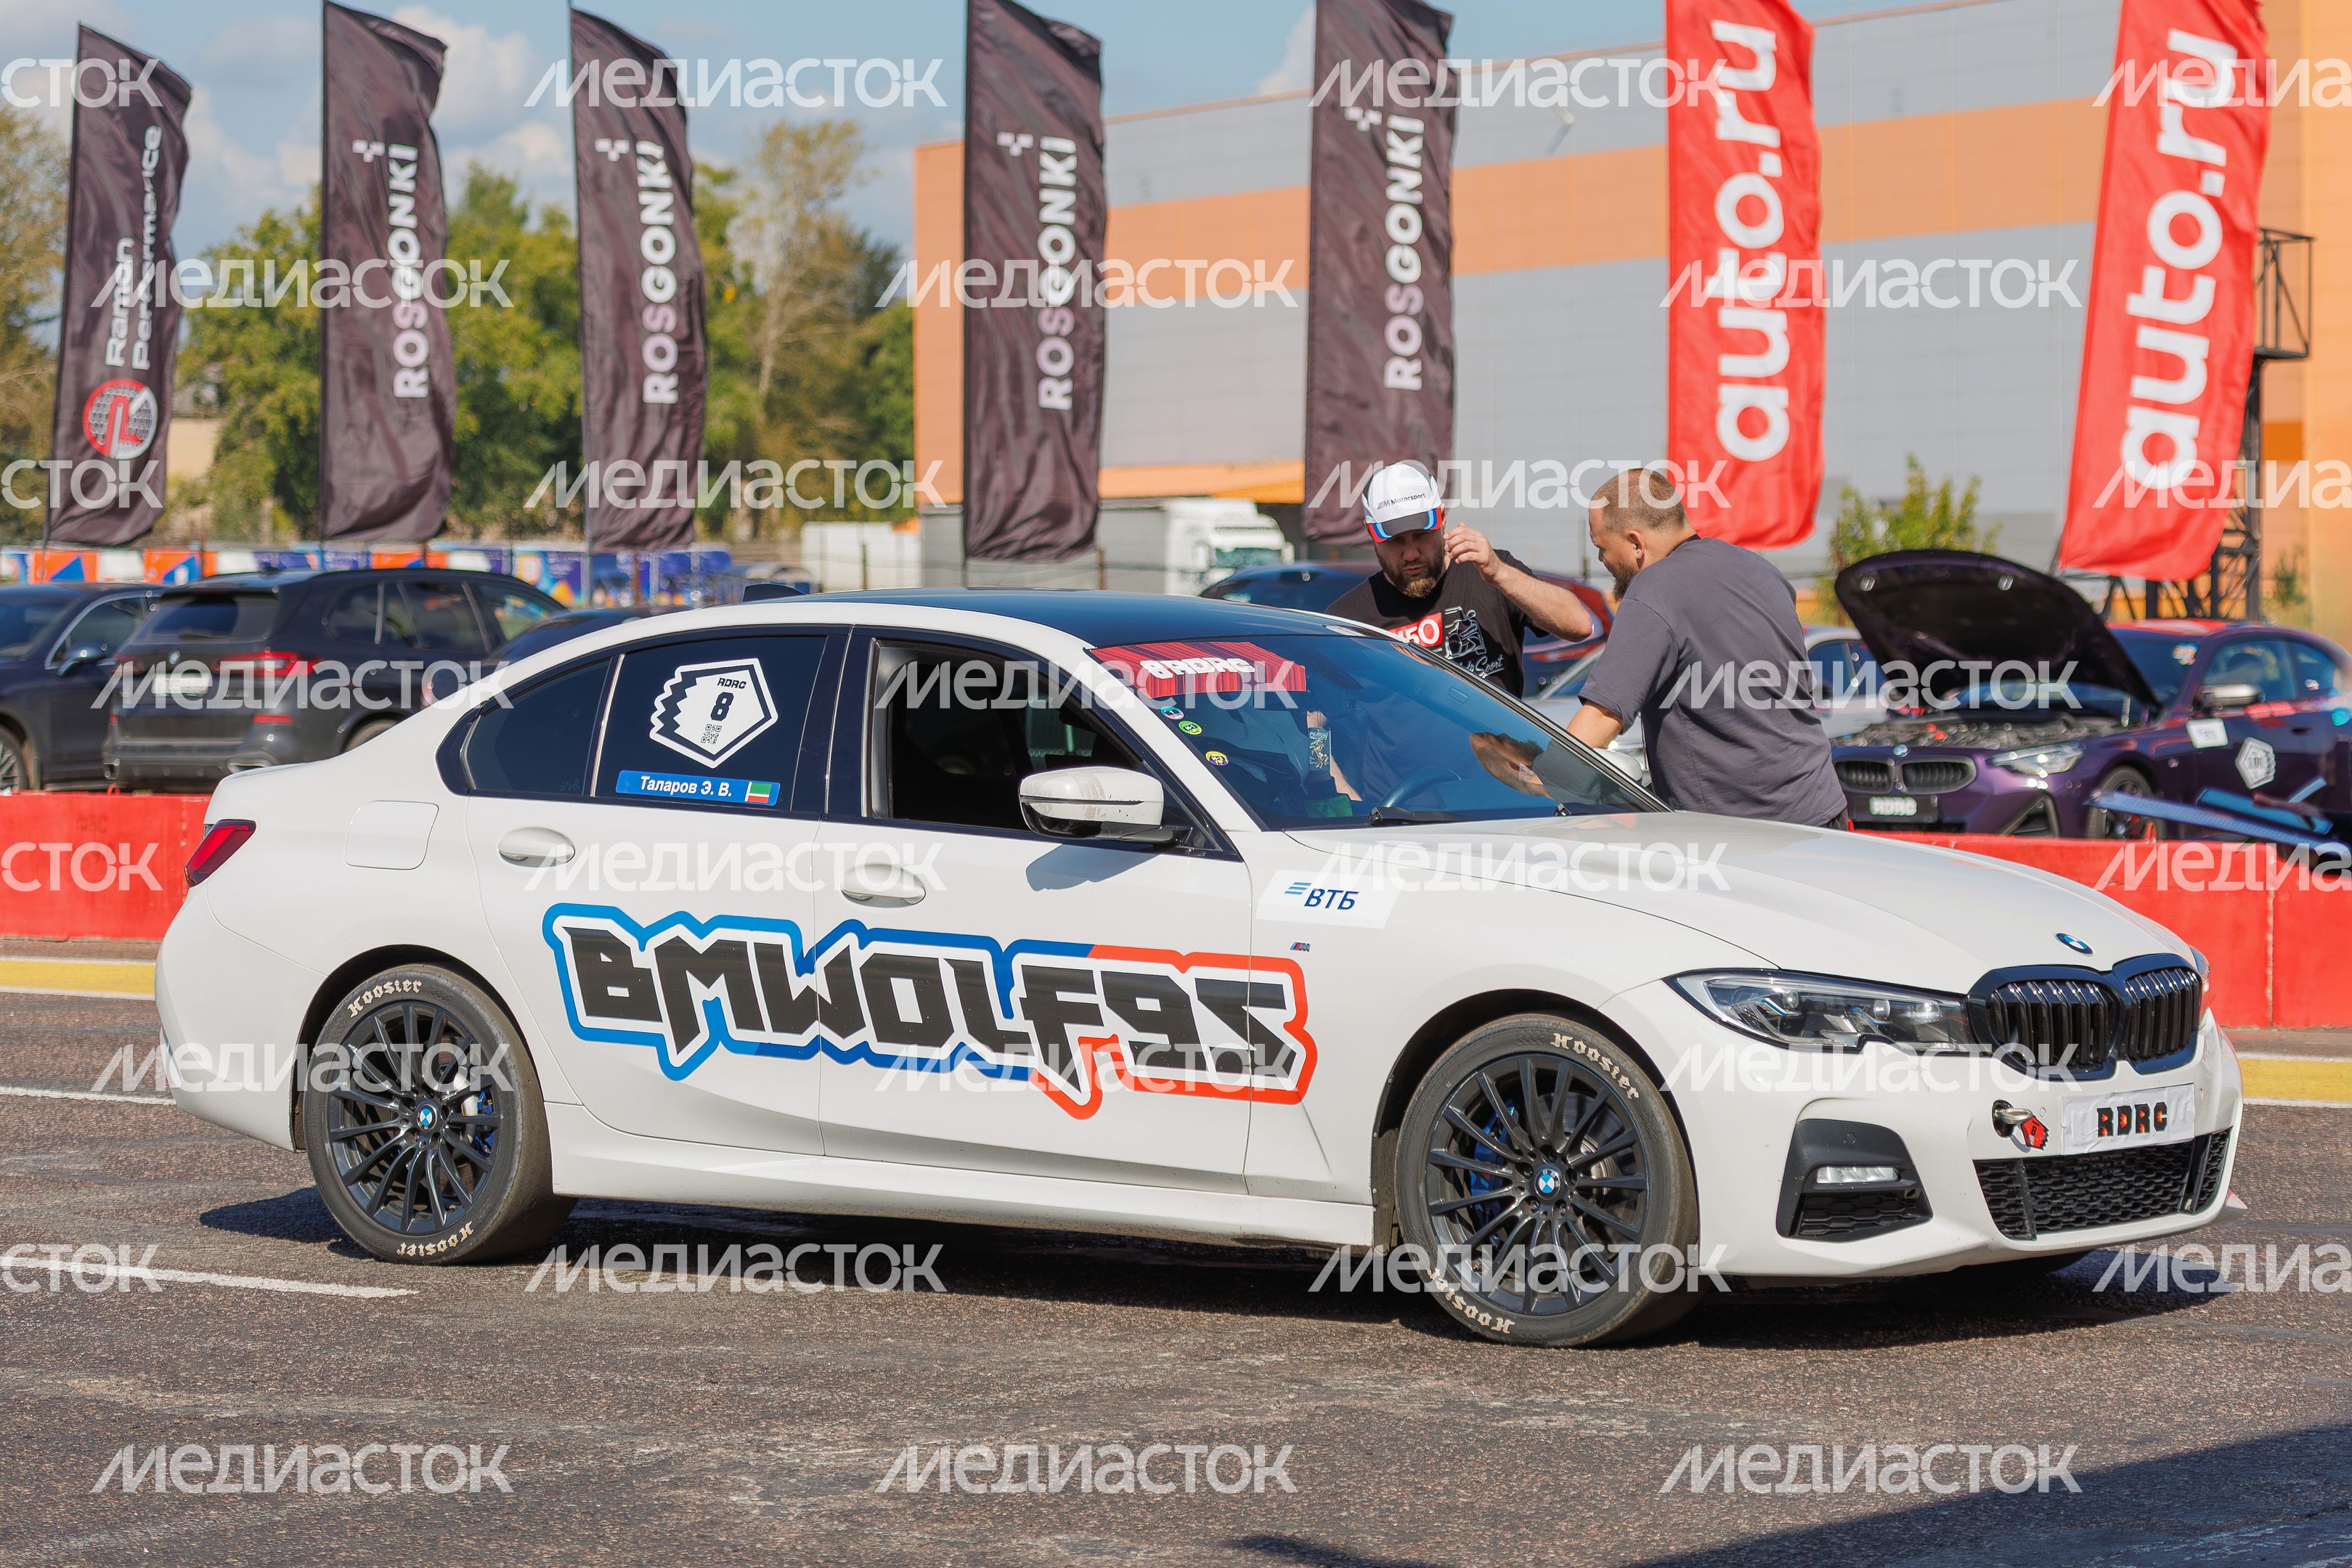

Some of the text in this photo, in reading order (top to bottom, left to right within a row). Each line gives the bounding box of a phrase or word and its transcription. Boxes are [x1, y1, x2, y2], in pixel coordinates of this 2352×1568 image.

[1383, 114, 1425, 391] ROSGONKI
[1704, 20, 1790, 462] auto.ru
[2120, 28, 2239, 490] auto.ru
[388, 144, 429, 399] ROSGONKI
[635, 140, 679, 404] ROSGONKI
[1036, 135, 1078, 412] ROSGONKI
[1391, 493, 1426, 505] Motorsport
[710, 692, 734, 722] 8
[717, 677, 746, 690] RDRC
[640, 775, 732, 797] Таларов Э. В.
[1304, 888, 1359, 910] ВТБ
[348, 979, 422, 1018] Hoosier
[1550, 1033, 1640, 1100] Hoosier
[2096, 1101, 2168, 1138] RDRC
